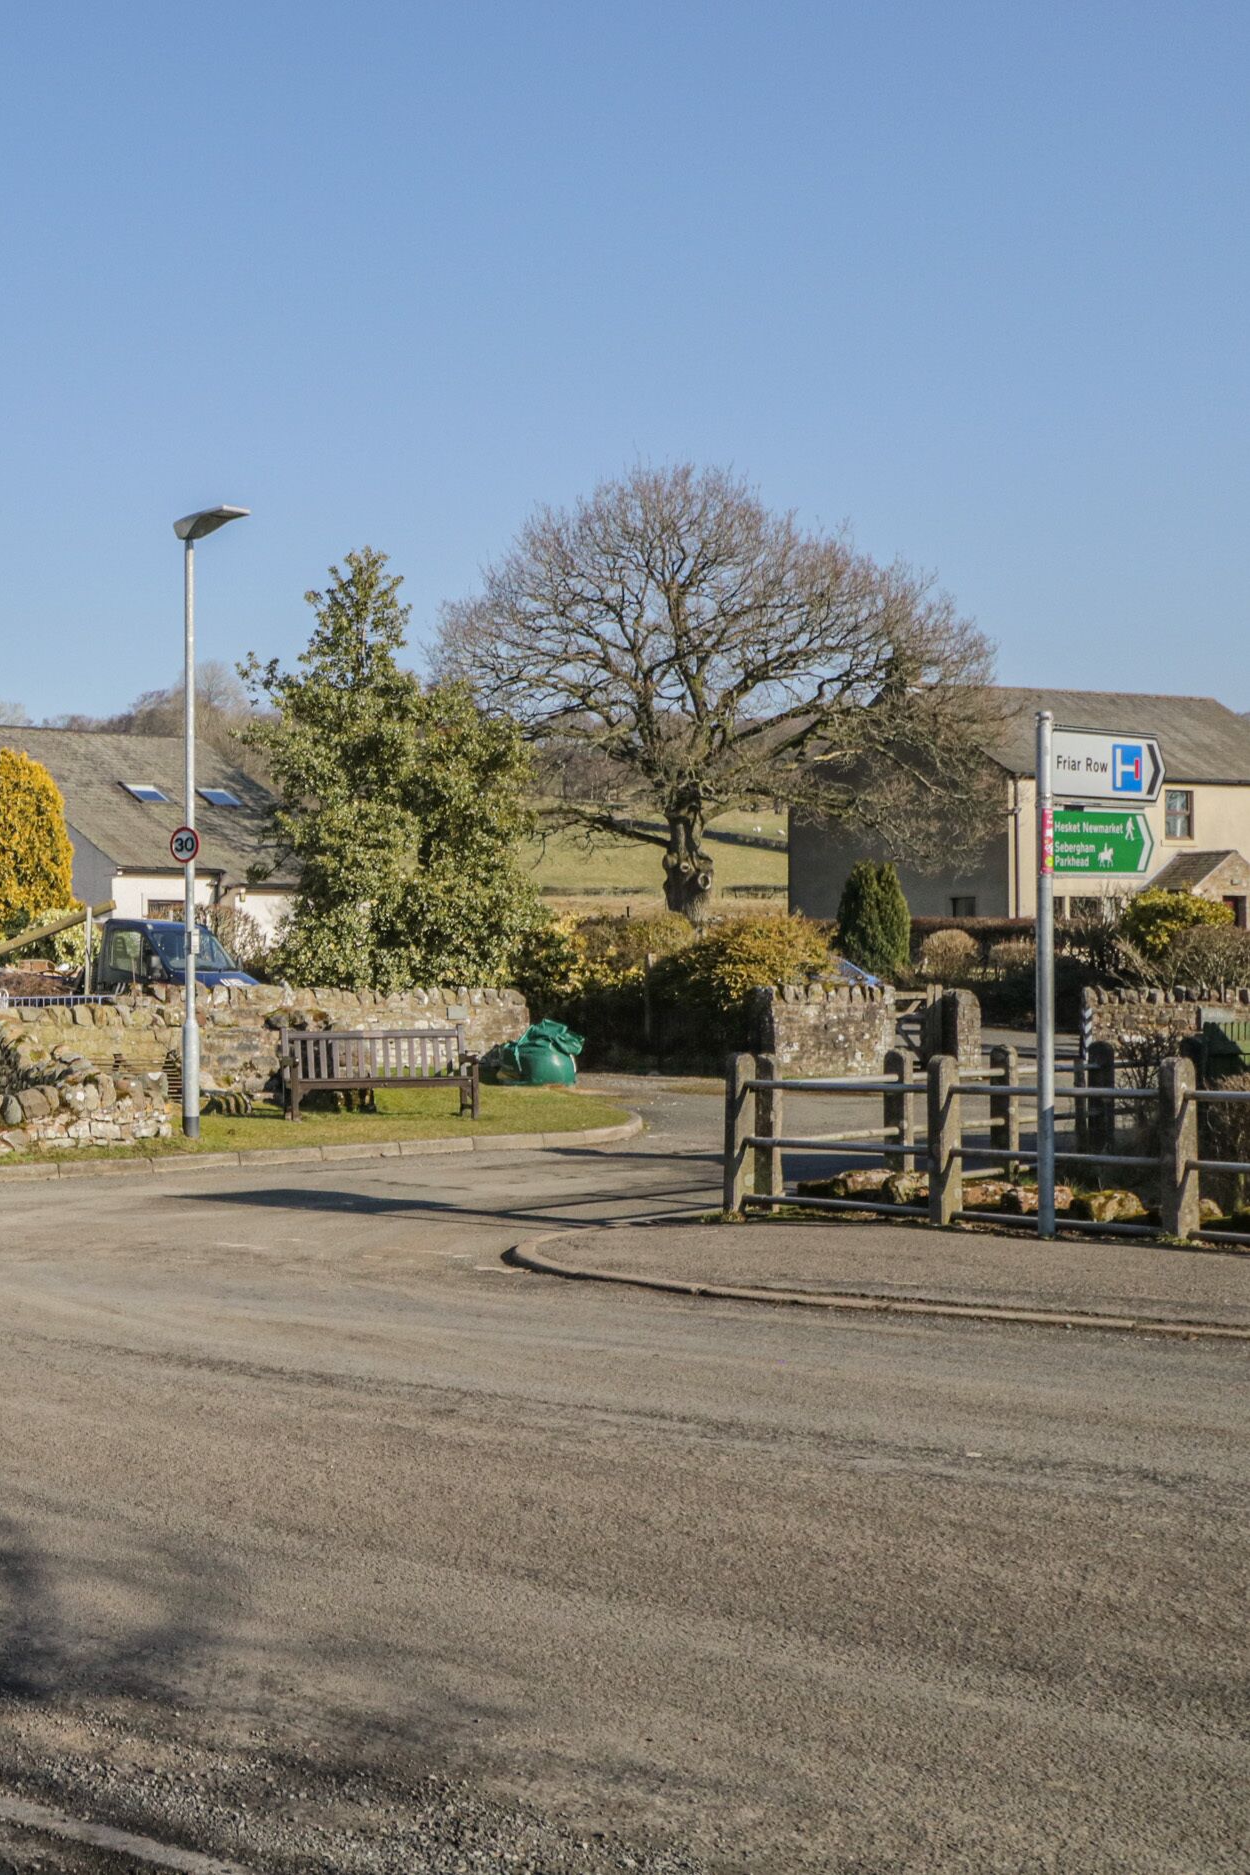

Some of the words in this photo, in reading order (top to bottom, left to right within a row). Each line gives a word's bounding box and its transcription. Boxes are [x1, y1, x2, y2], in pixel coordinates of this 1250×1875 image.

[1056, 754, 1081, 771] Friar
[1085, 757, 1108, 773] Row
[1054, 821, 1080, 833] Hesket
[1082, 821, 1124, 834] Newmarket
[174, 837, 195, 852] 30
[1054, 841, 1096, 855] Sebergham
[1054, 855, 1090, 867] Parkhead
